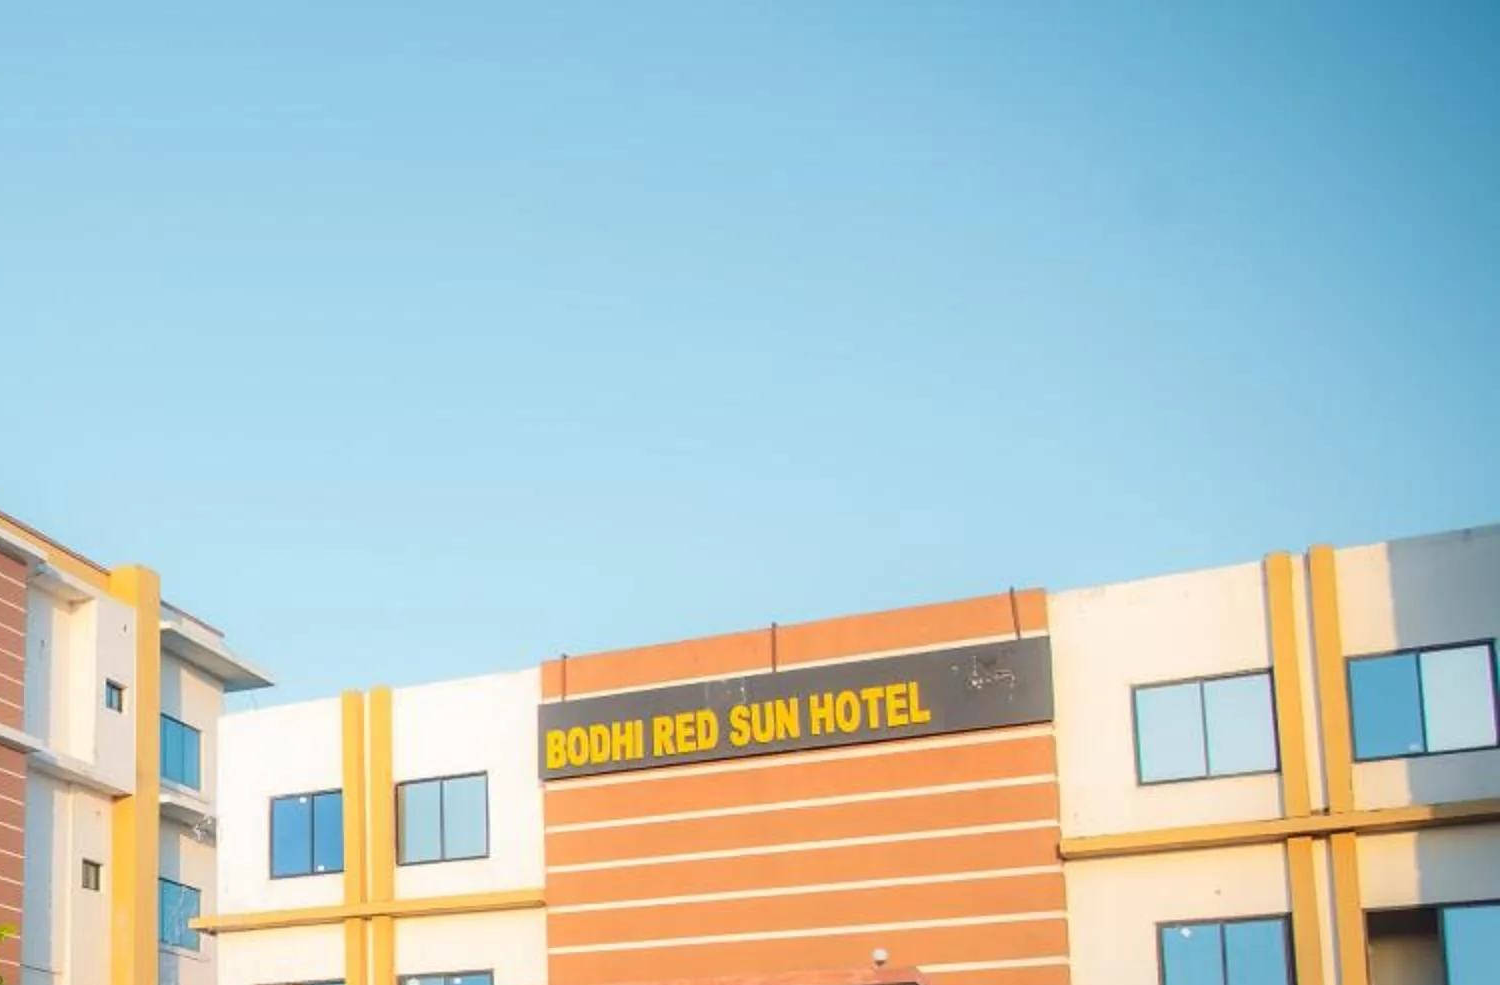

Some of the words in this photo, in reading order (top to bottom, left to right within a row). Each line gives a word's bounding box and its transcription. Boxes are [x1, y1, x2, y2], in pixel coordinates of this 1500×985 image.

[545, 719, 644, 769] BODHI
[652, 708, 719, 756] RED
[729, 696, 799, 747] SUN
[809, 680, 932, 737] HOTEL
